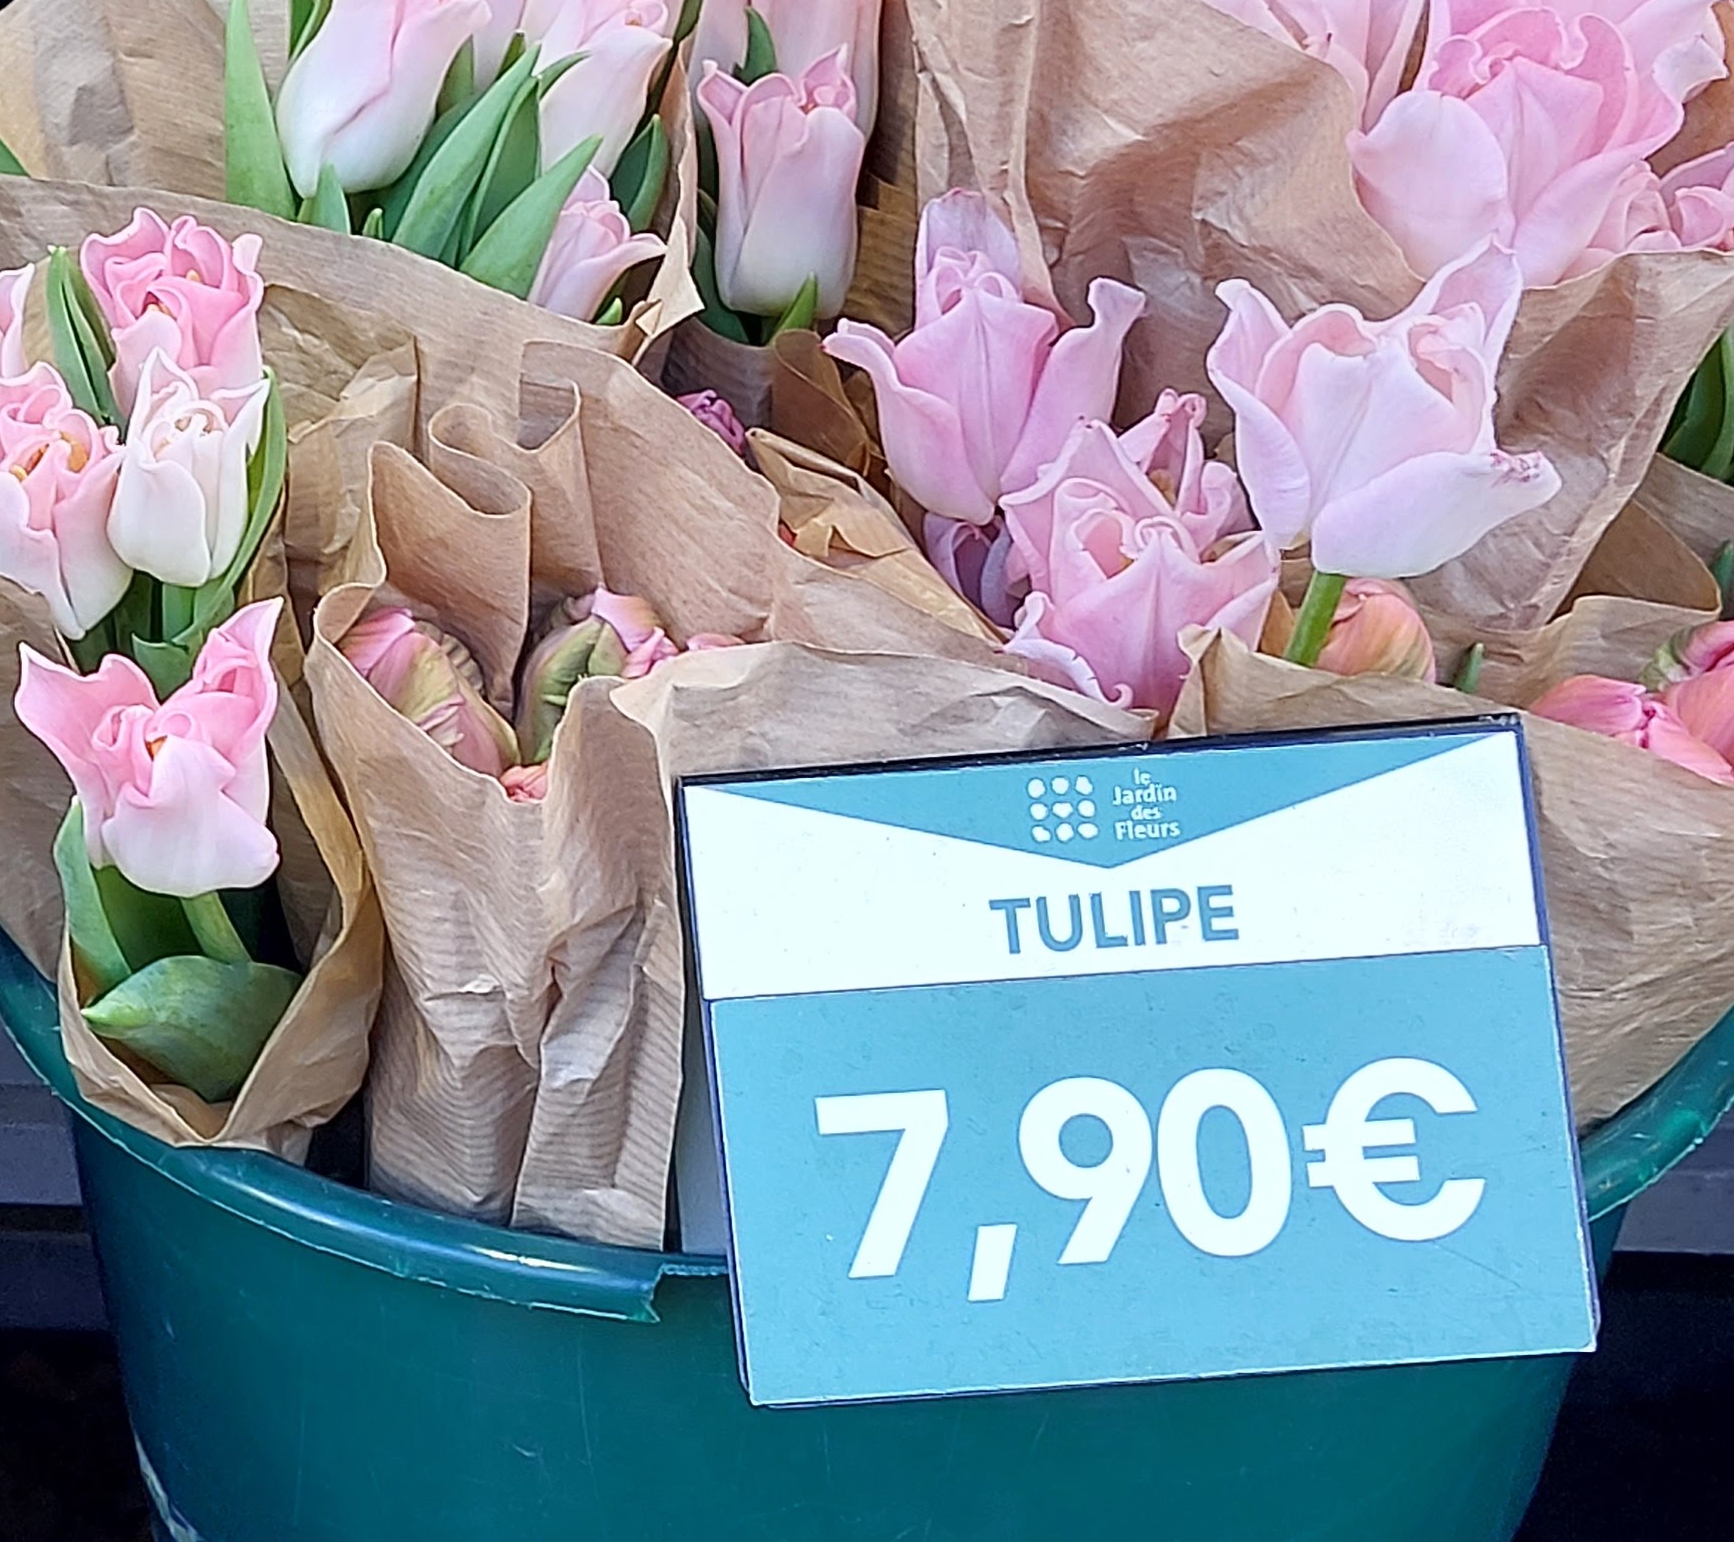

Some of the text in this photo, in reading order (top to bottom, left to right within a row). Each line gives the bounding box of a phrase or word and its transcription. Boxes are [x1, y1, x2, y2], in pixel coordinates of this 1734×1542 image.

[1133, 767, 1152, 785] le
[1112, 784, 1178, 805] Jardin
[1131, 805, 1164, 820] des
[1115, 820, 1181, 840] Fleurs
[988, 884, 1240, 955] TULIPE
[814, 1057, 1486, 1303] 7,90€
